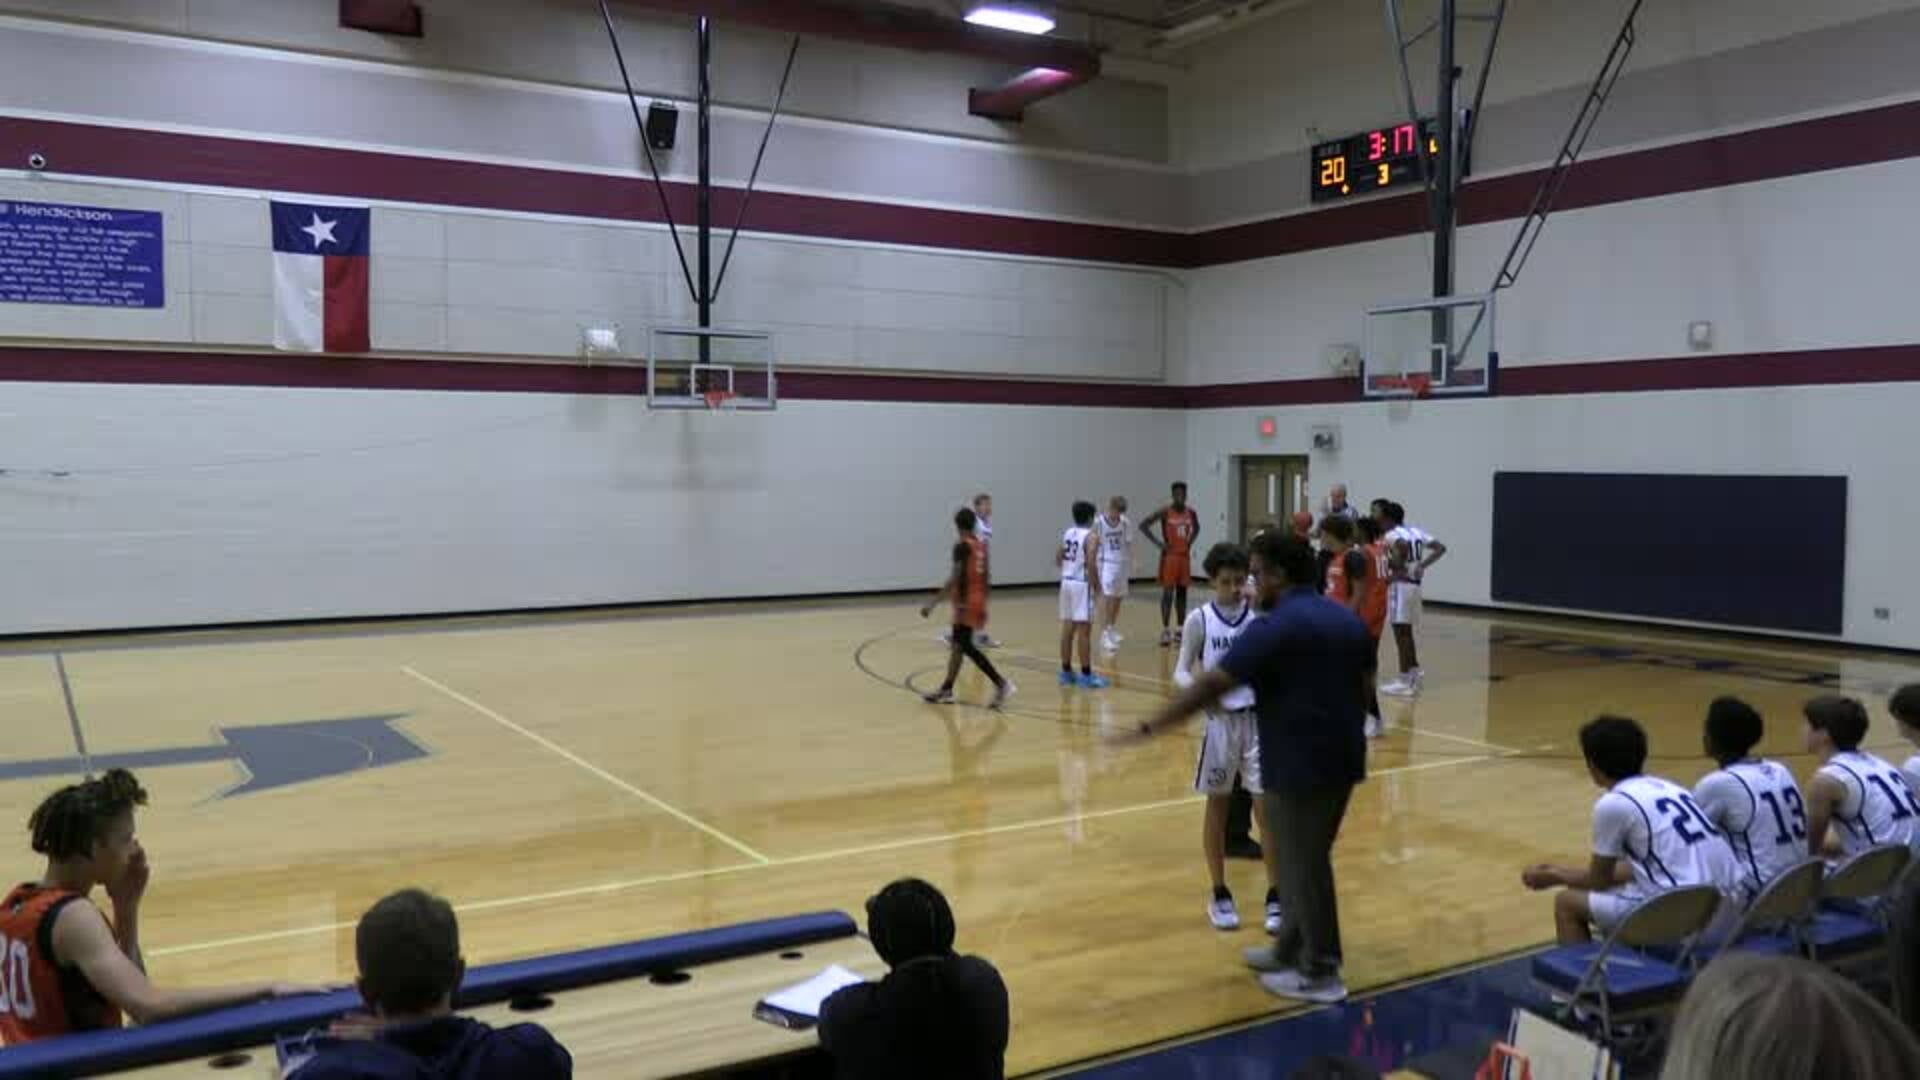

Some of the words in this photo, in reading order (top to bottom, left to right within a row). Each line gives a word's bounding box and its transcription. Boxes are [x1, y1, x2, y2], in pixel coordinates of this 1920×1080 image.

[1368, 125, 1415, 160] 3:17
[1320, 155, 1346, 186] 20
[1377, 163, 1390, 185] 3
[1760, 787, 1807, 845] 13
